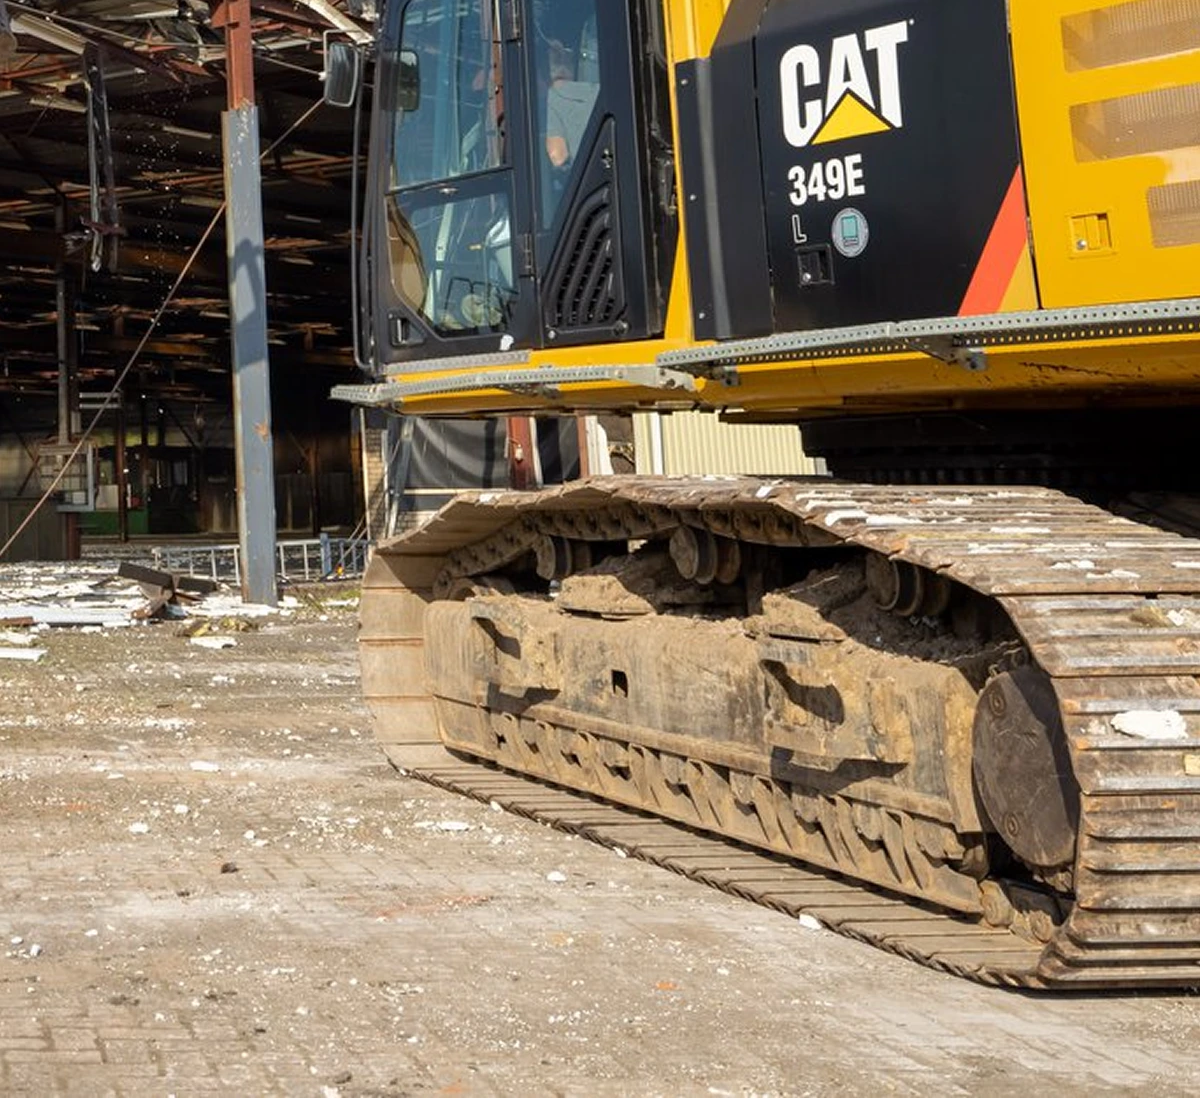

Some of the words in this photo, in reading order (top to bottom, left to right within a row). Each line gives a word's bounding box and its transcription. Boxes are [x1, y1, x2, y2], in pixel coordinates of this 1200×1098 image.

[780, 20, 906, 147] CAT
[788, 154, 865, 206] 349E
[792, 215, 807, 243] L
